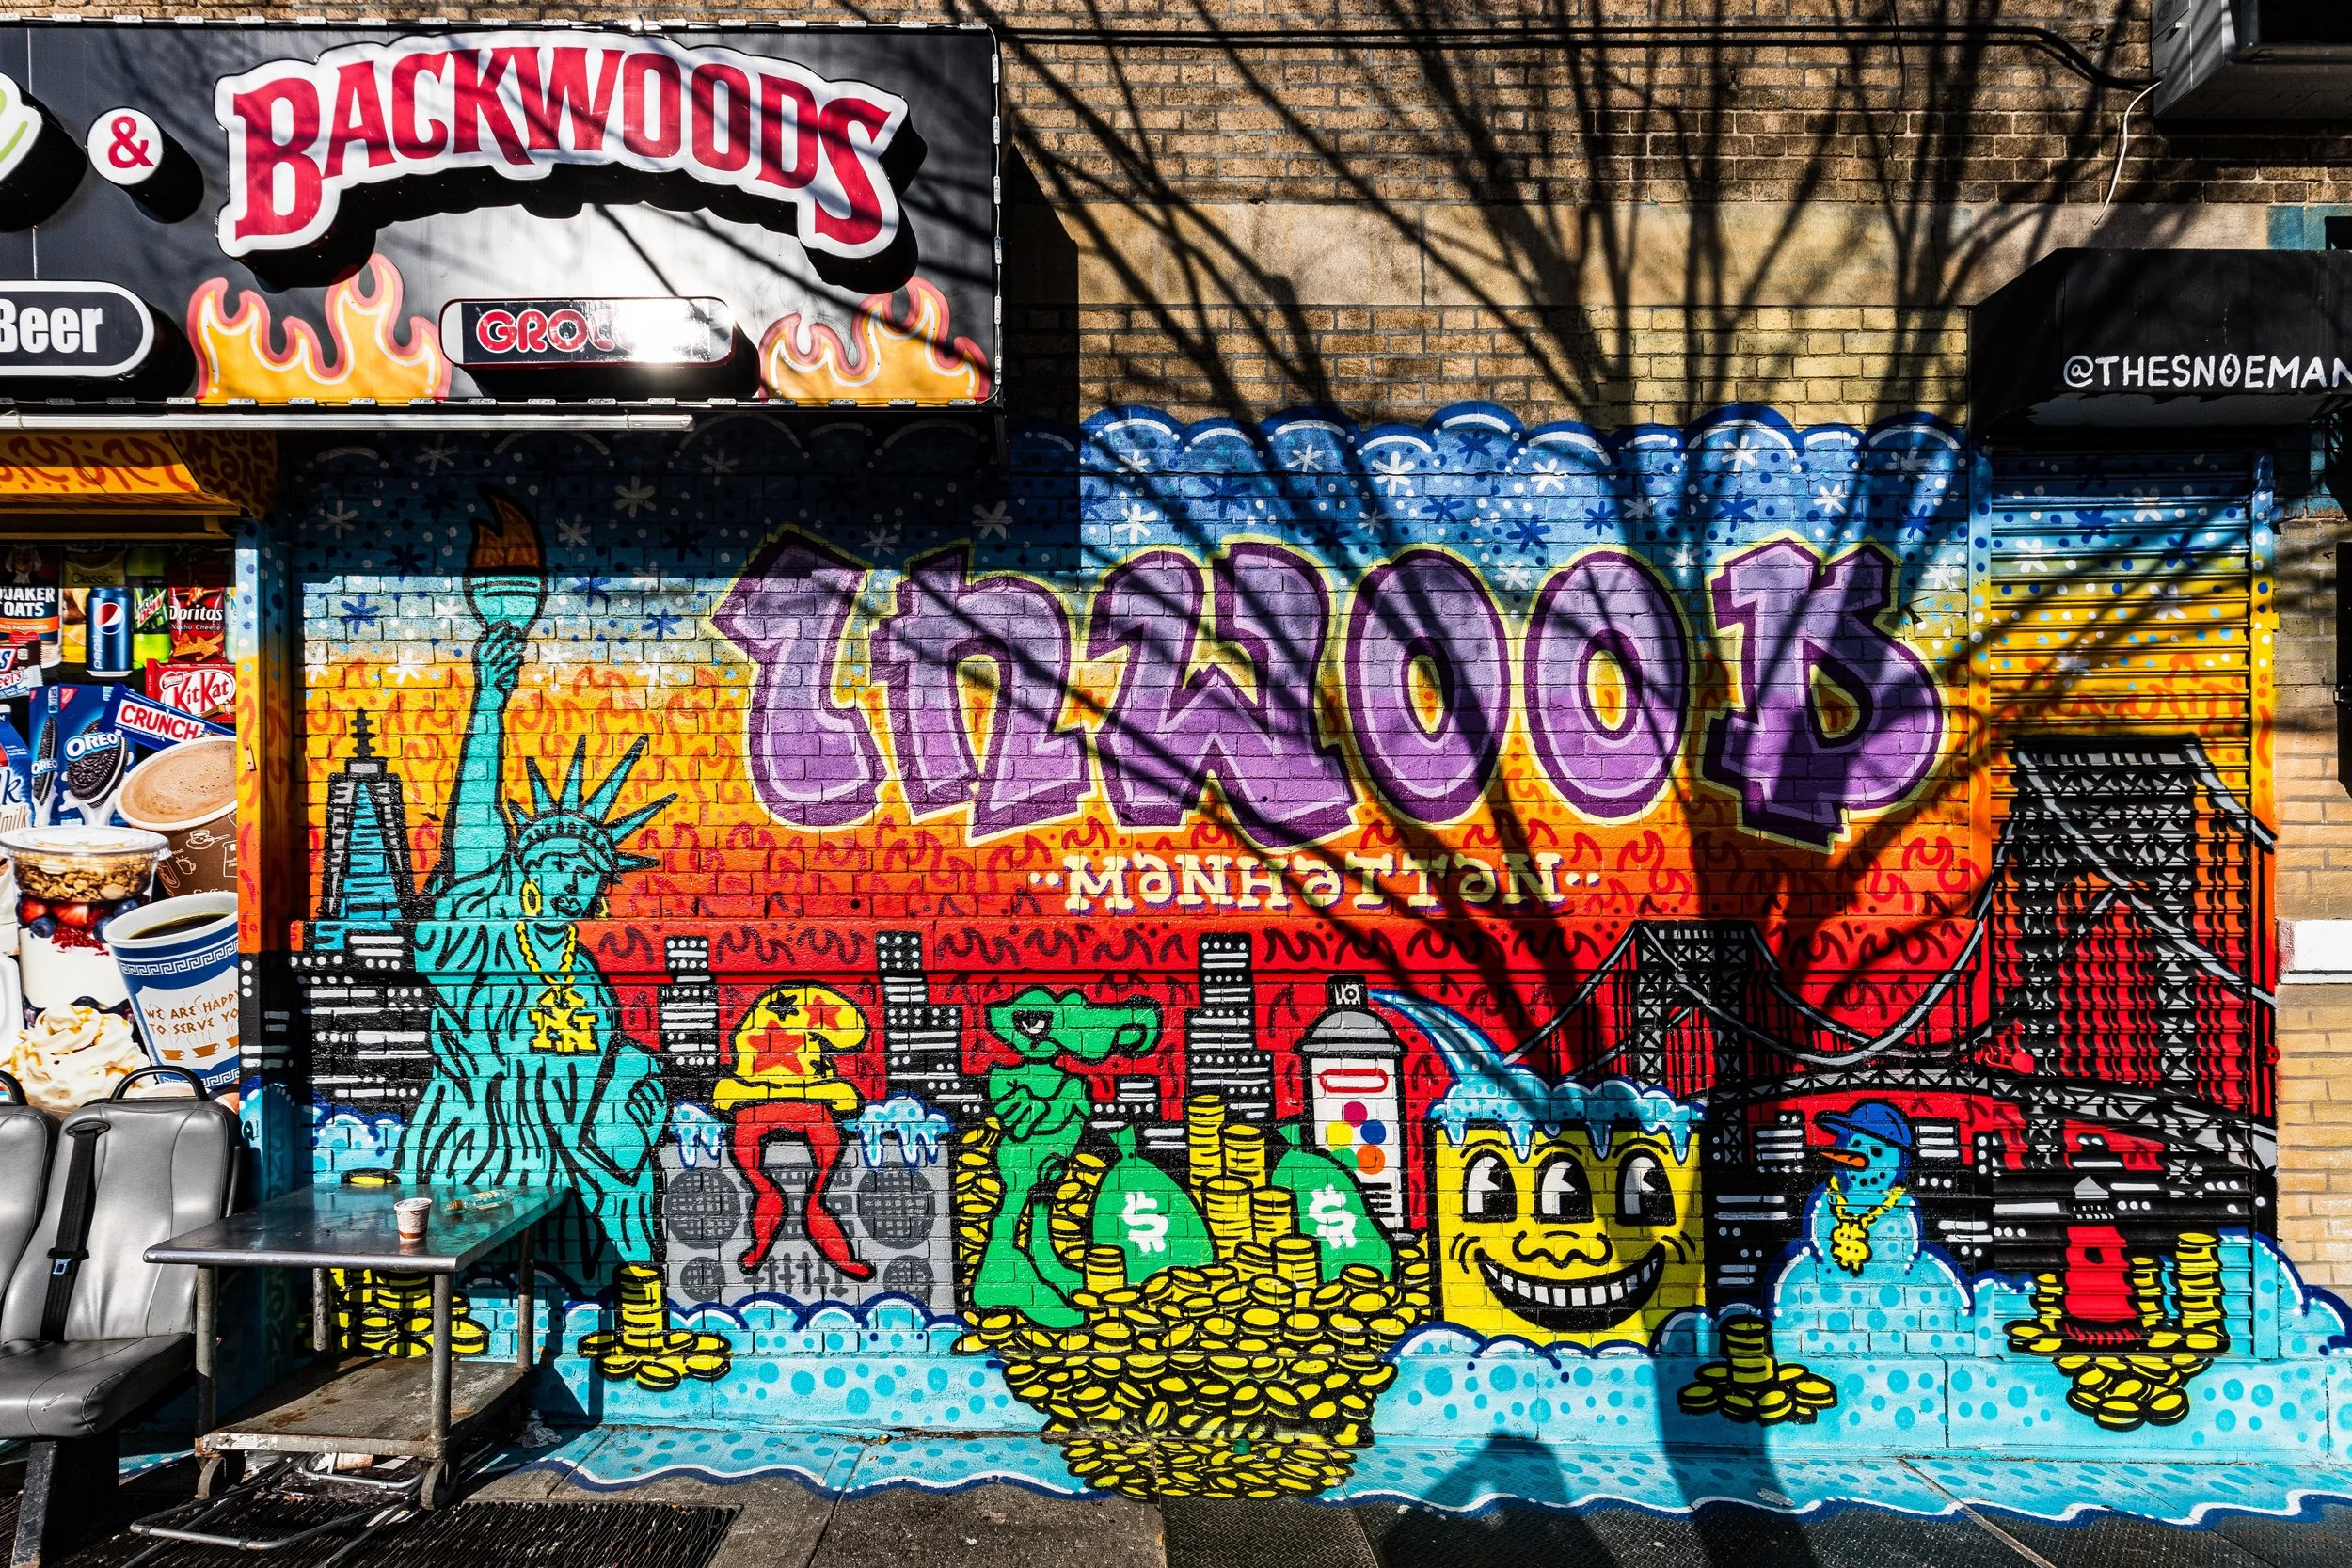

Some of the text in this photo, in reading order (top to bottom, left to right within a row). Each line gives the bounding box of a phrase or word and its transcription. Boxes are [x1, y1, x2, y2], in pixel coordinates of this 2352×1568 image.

[108, 116, 154, 169] &
[233, 47, 892, 245] BACKWOODS
[0, 299, 103, 354] Beer
[72, 572, 114, 584] Classic
[0, 587, 56, 602] UAKER
[4, 602, 44, 617] OATS
[169, 605, 224, 621] Doritos
[93, 635, 103, 669] pepsi
[120, 704, 199, 740] CRUNCH
[66, 732, 117, 757] OREO
[31, 760, 57, 775] OREO
[145, 1008, 165, 1020] WE
[170, 1006, 196, 1019] ARE
[149, 1023, 166, 1035] TO
[173, 1017, 214, 1035] SERVE
